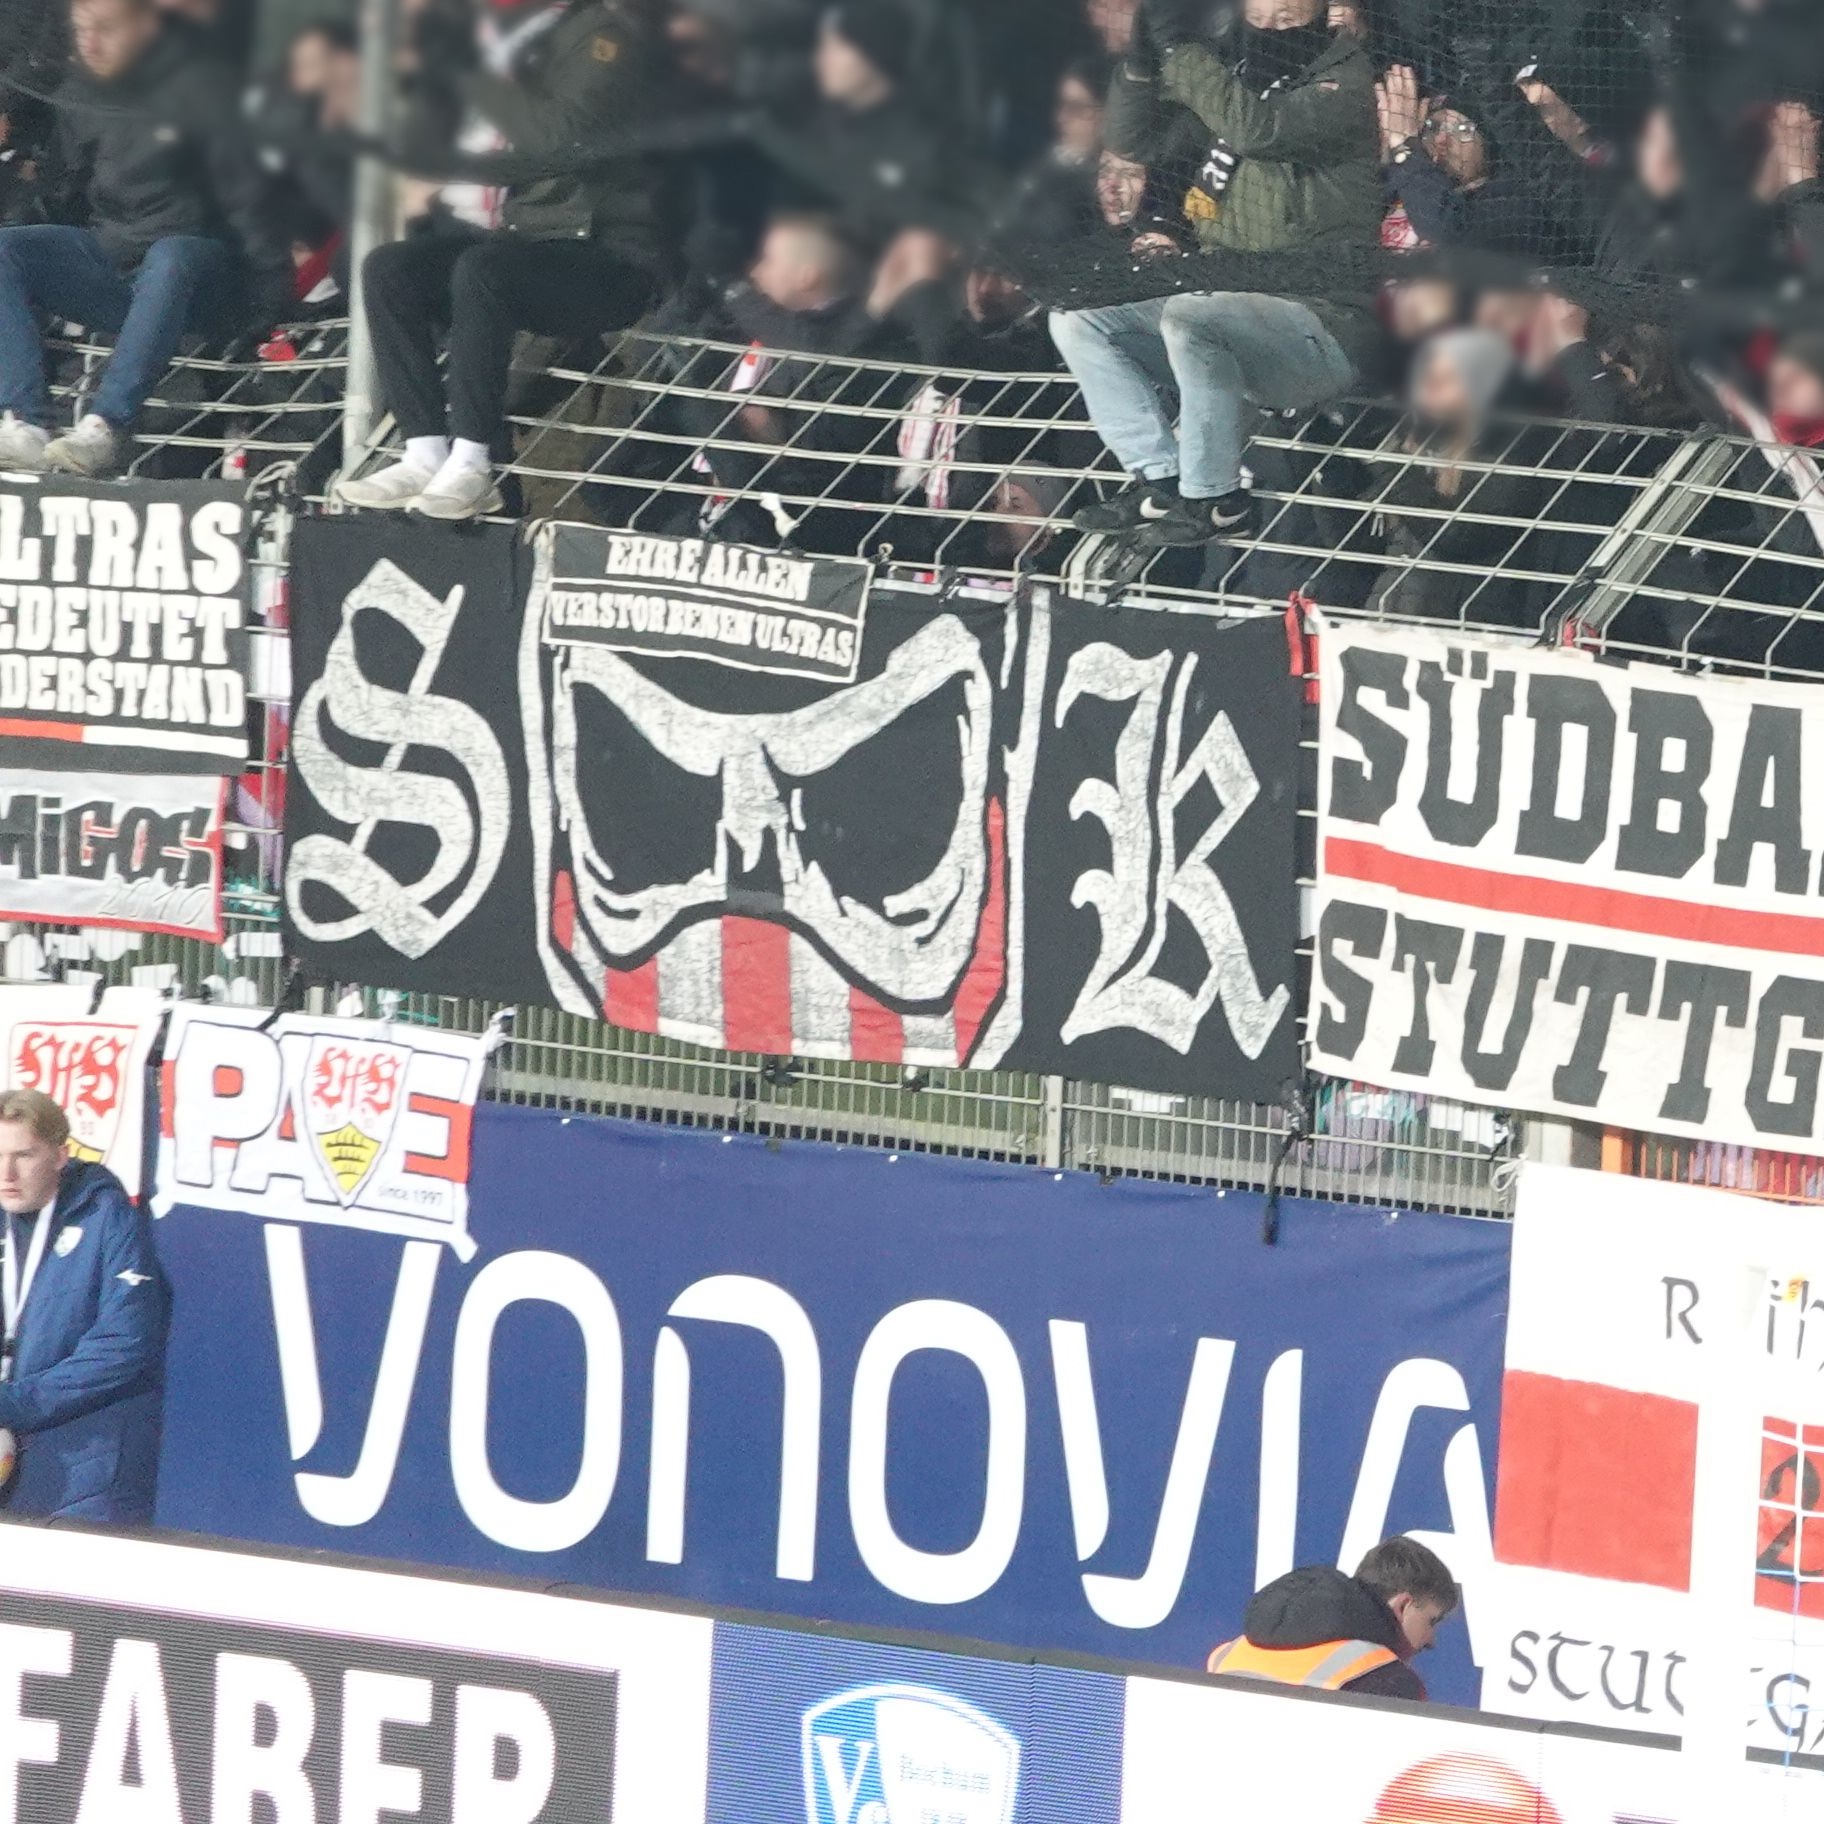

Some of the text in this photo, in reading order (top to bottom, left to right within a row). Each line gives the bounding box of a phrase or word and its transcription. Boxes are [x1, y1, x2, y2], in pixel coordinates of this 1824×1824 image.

[605, 534, 815, 601] EHRE ALLEN
[550, 590, 854, 668] VERSTORBENEN ULTRAS
